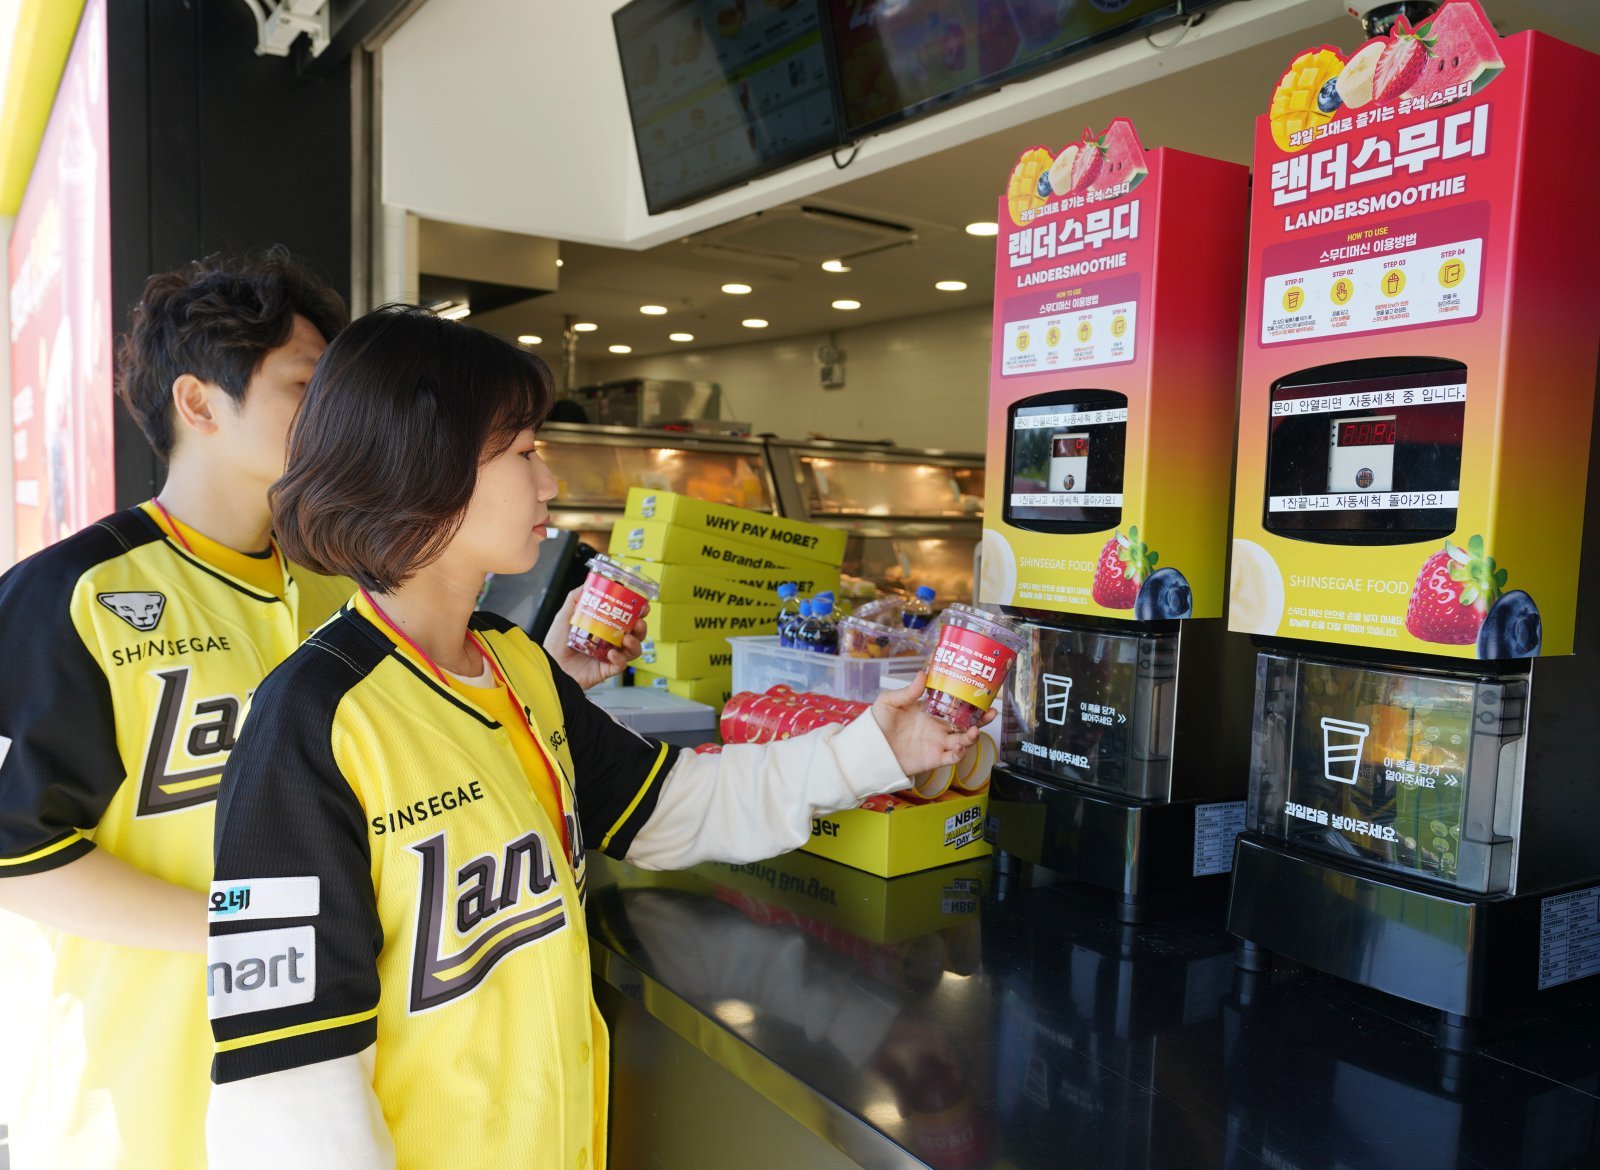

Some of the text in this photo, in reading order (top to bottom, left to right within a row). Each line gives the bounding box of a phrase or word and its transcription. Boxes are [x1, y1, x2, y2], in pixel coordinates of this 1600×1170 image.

[1289, 81, 1472, 147] 과일 그대로 즐기는 즉석 스무디
[1271, 104, 1490, 206] 랜더스무디
[1037, 203, 1059, 218] 그대로
[1060, 197, 1084, 213] 즐기는
[1103, 182, 1130, 200] 스무디
[1285, 175, 1466, 231] LANDERSMOOTHIE
[1008, 199, 1140, 268] 랜더스무디
[1347, 227, 1388, 242] HOW TO USE
[1320, 233, 1418, 263] 스무디머신 이용방법
[1440, 248, 1466, 259] STEP 04
[1017, 252, 1127, 288] LANDERSMOOTHIE
[1332, 268, 1354, 278] STEP 02
[1383, 261, 1398, 269] STEP
[1284, 278, 1298, 286] STEP
[1039, 300, 1071, 314] 스무디머신
[1273, 386, 1465, 414] 문이 안열리면 자동세척 중 입니다.
[1282, 493, 1444, 510] 1잔끝나고 자동세척 돌아가요!
[706, 514, 819, 549] WHY PAY MORE?
[701, 545, 721, 560] No
[721, 551, 762, 570] Brand
[1020, 557, 1095, 572] SHINSEGAE FOOD
[1289, 575, 1409, 595] SHINSEGAE FOOD
[692, 586, 754, 607] WHY PAY
[694, 617, 727, 629] WHY
[730, 617, 757, 629] PAY
[112, 636, 231, 666] SHINSEGAE
[1080, 702, 1116, 717] 이 쪽을 당겨
[1081, 712, 1113, 726] 열어주세요
[1021, 741, 1091, 769] 과일컵을 넣어주세요.
[1383, 756, 1441, 777] 이 쪽을 당겨
[1385, 769, 1436, 789] 열어주세요
[1284, 801, 1399, 843] 과일컵을 넣어주세요.
[956, 833, 971, 847] DAY
